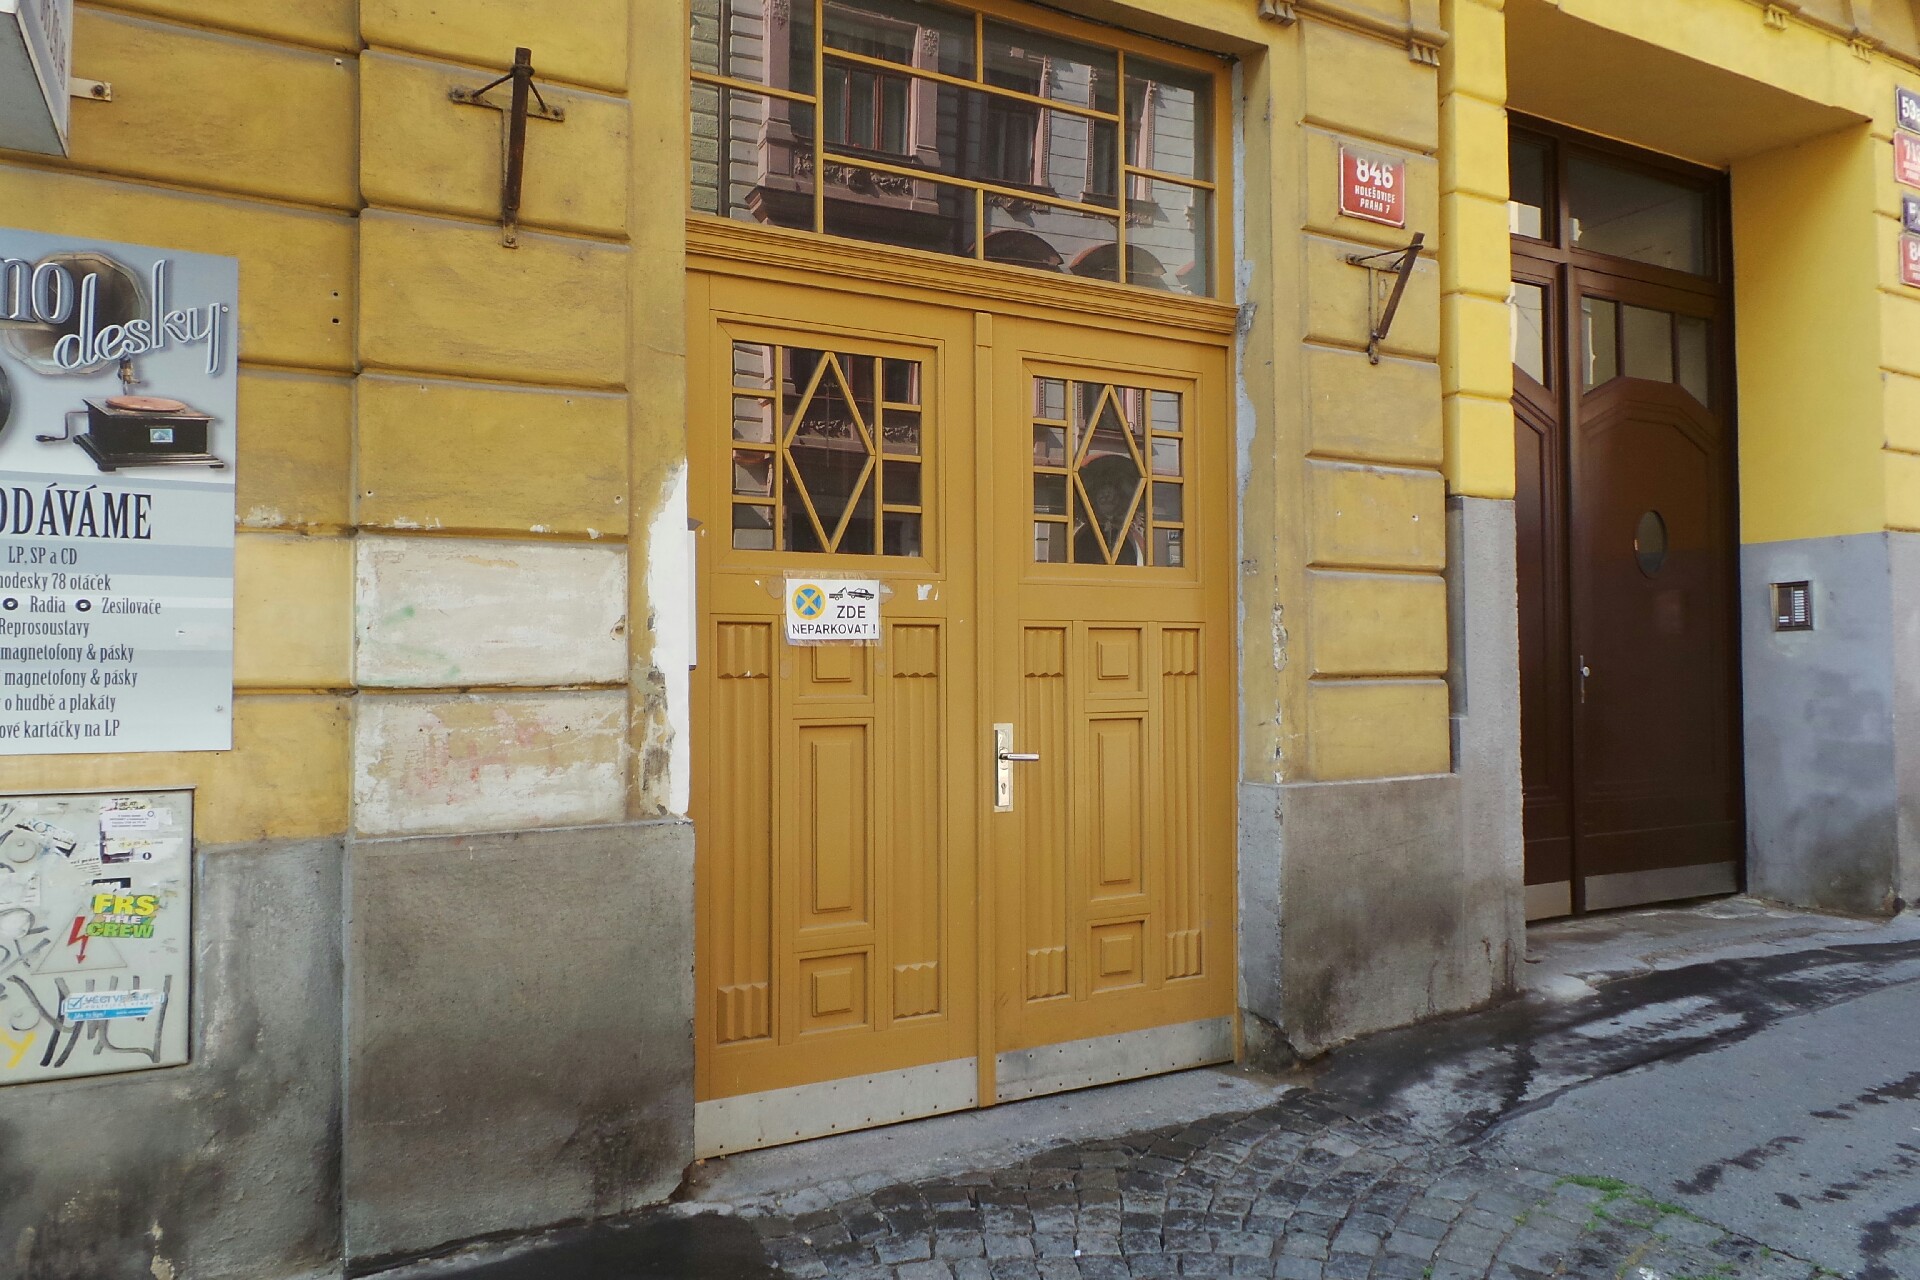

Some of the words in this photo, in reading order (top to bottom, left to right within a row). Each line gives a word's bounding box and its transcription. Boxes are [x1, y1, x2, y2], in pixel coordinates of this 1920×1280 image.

[1356, 157, 1394, 188] 846
[1354, 184, 1396, 204] HOLEŠOVICE
[1360, 198, 1383, 212] PRAHA
[1385, 204, 1390, 214] 7
[53, 259, 222, 375] desky
[30, 547, 46, 564] SP
[50, 551, 57, 565] a
[61, 547, 77, 565] CD
[52, 573, 66, 589] 78
[70, 574, 111, 591] otáček
[30, 595, 66, 613] Radia
[102, 597, 162, 615] Zesilovače
[836, 605, 866, 619] ZDE
[0, 617, 90, 638] Reprosoustavy
[792, 623, 869, 635] NEPARKOVAT
[0, 643, 83, 663] magnetofony
[86, 643, 96, 660] &
[100, 643, 134, 663] pásky
[4, 668, 87, 688] magnetofony
[90, 668, 100, 685] &
[104, 668, 138, 688] pásky
[4, 697, 12, 711] o
[15, 692, 55, 711] hudbě
[58, 698, 66, 711] a
[69, 693, 116, 713] plakáty
[24, 720, 80, 740] kartáčky
[84, 723, 100, 737] na
[104, 719, 120, 737] LP
[93, 893, 156, 916] FRS
[103, 914, 142, 924] THE
[87, 922, 154, 938] CREW
